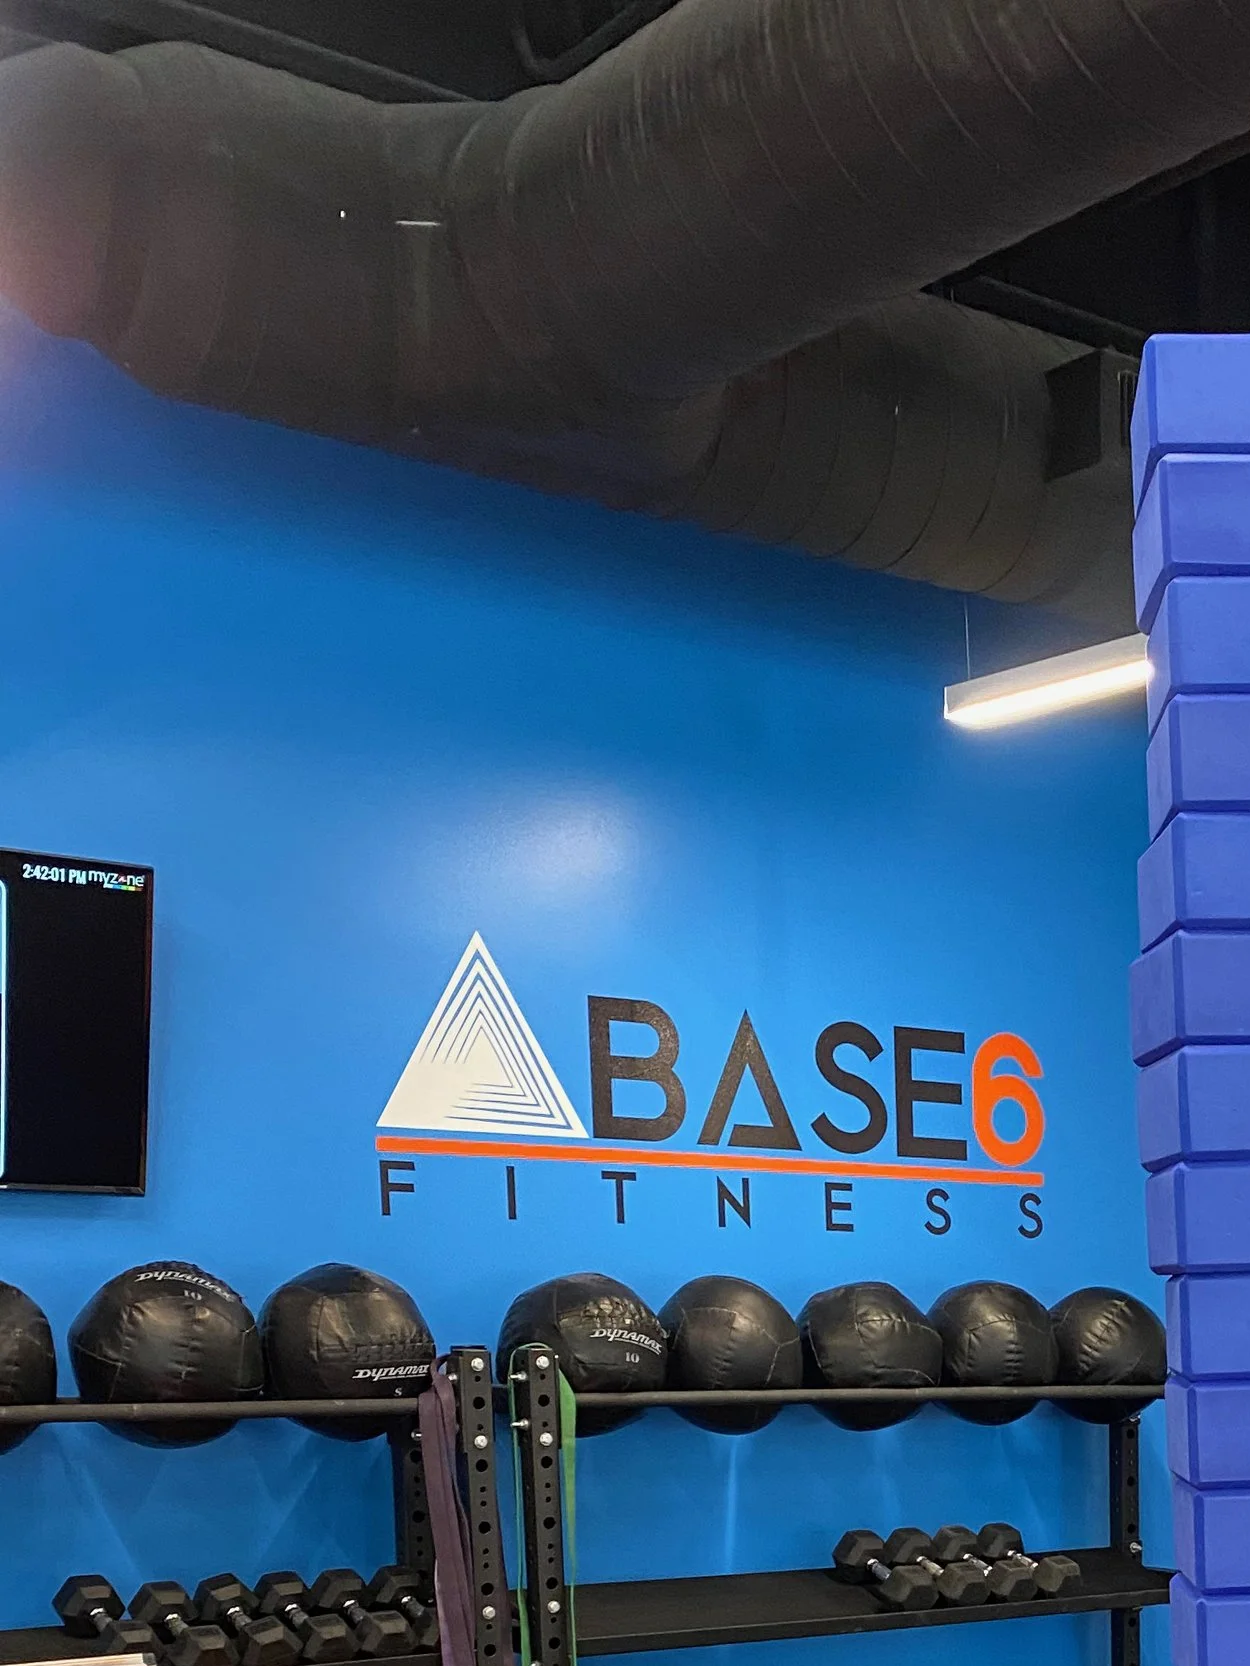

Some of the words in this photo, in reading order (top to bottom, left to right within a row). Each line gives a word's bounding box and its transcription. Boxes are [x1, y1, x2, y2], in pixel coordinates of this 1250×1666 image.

[22, 863, 65, 882] 2:42:01
[68, 869, 87, 885] PM
[587, 994, 1046, 1168] BASE6
[378, 1159, 1045, 1240] FITNESS
[625, 1352, 640, 1363] 10
